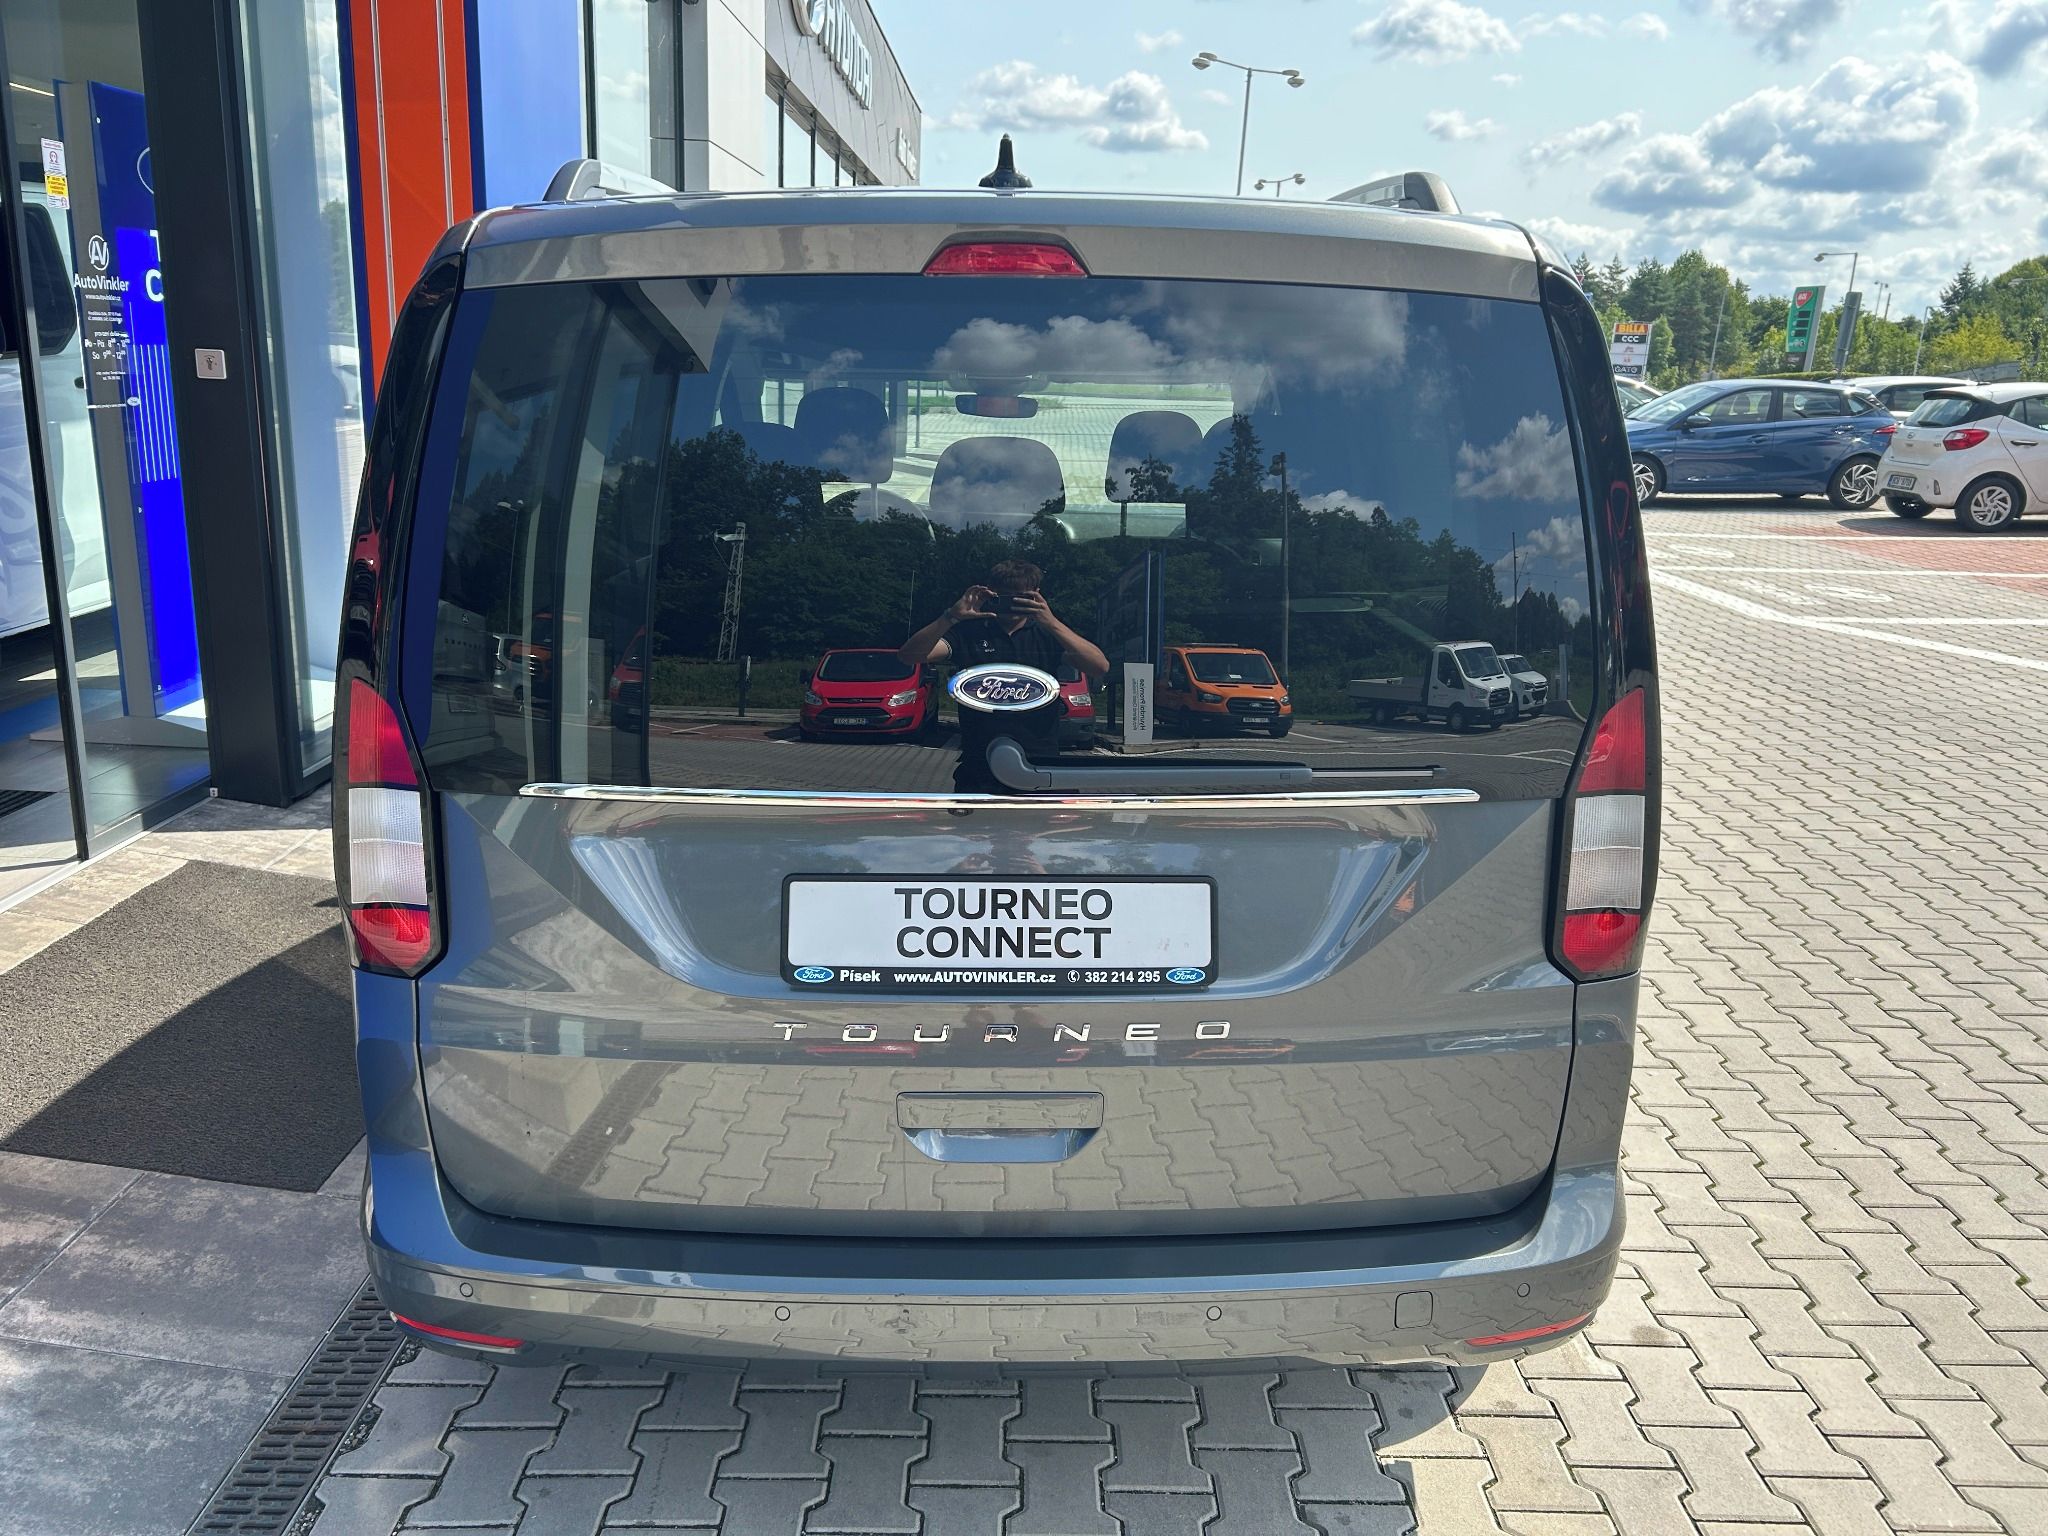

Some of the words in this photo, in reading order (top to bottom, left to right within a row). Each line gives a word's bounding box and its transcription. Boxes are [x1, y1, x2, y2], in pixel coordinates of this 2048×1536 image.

[74, 273, 130, 292] AutoVinkler
[1618, 324, 1646, 333] BILLA
[1621, 335, 1640, 343] CCC
[976, 676, 1031, 700] Ford
[894, 887, 1113, 921] TOURNEO
[896, 925, 1112, 959] CONNECT
[839, 969, 881, 982] Písek
[894, 971, 1056, 983] www.AUTOVINKLER.cz
[1084, 970, 1107, 983] 382
[1111, 970, 1134, 983] 214
[1138, 970, 1161, 983] 295
[774, 1021, 1232, 1043] TOURNEO
